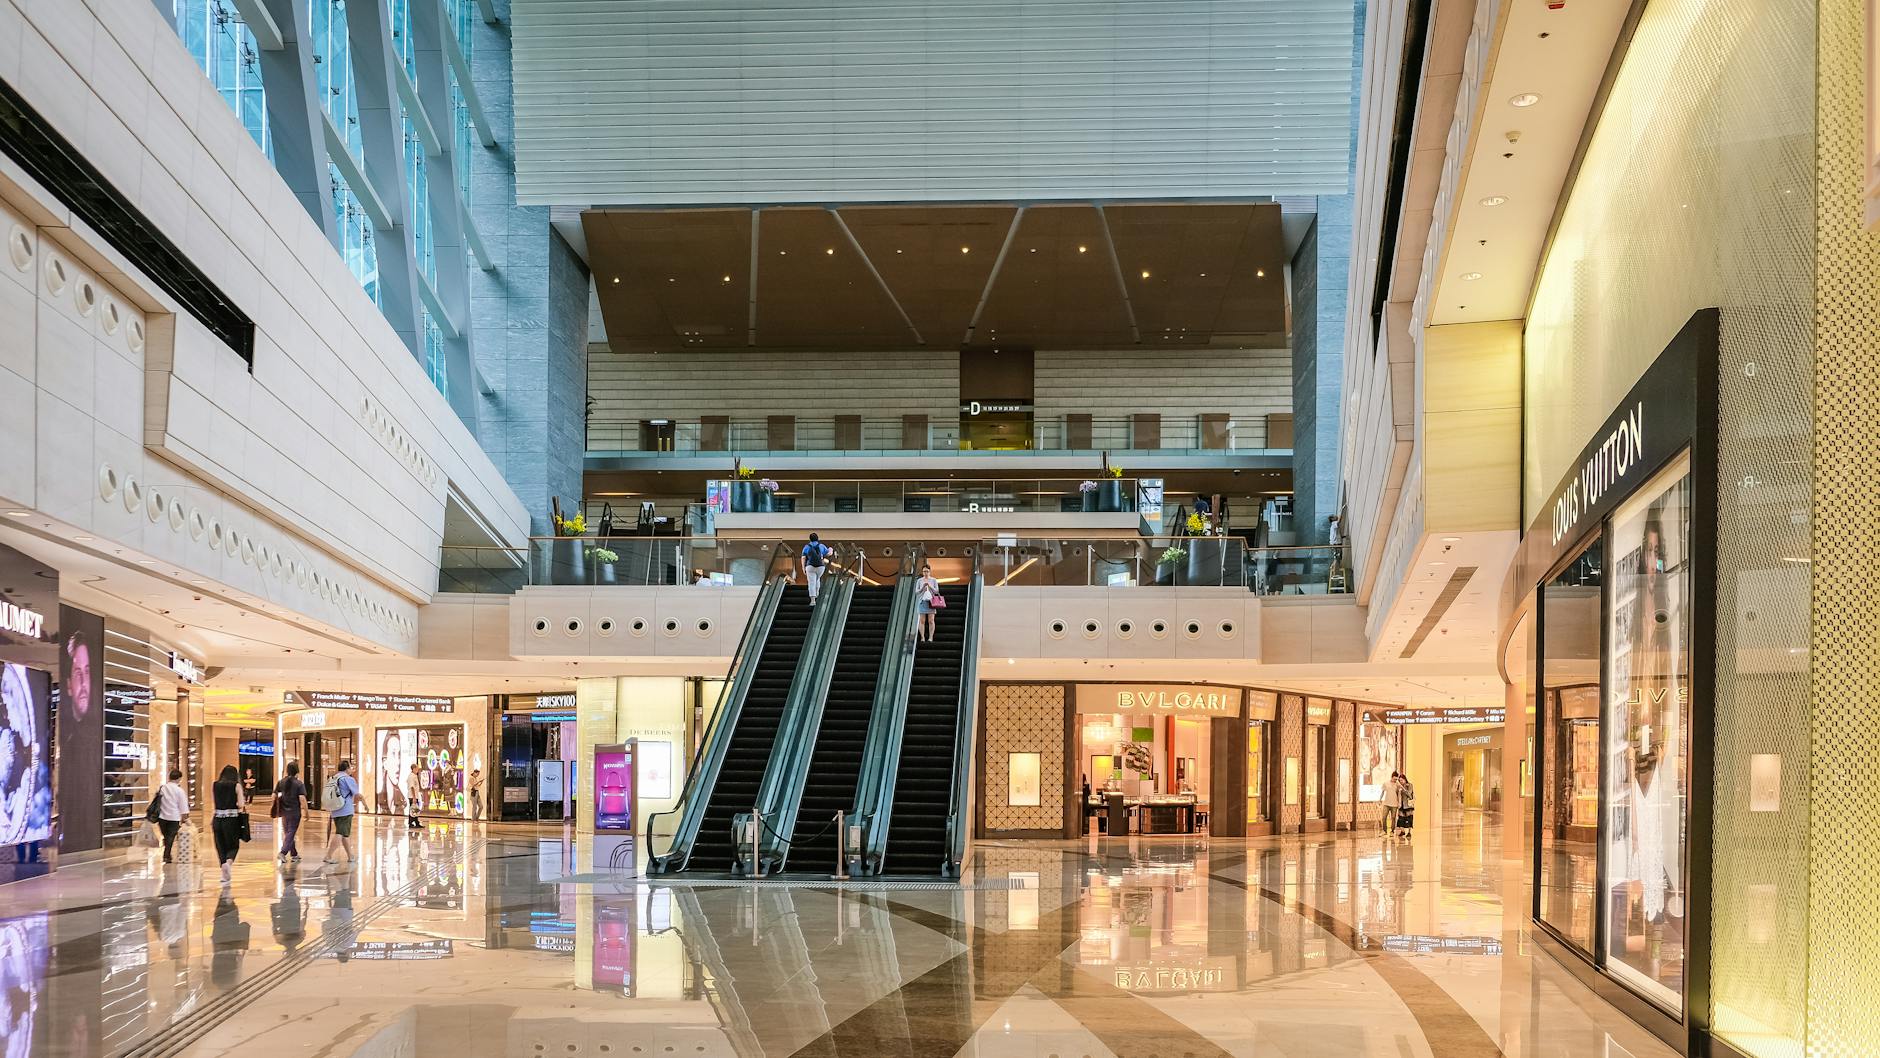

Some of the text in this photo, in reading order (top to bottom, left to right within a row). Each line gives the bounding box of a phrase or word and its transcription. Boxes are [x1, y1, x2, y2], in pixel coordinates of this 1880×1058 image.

[970, 401, 981, 416] D
[1552, 400, 1643, 547] LOUIS VUITTON
[0, 601, 44, 639] UMET
[551, 694, 576, 707] SKY100
[1118, 691, 1228, 711] BVLGARI
